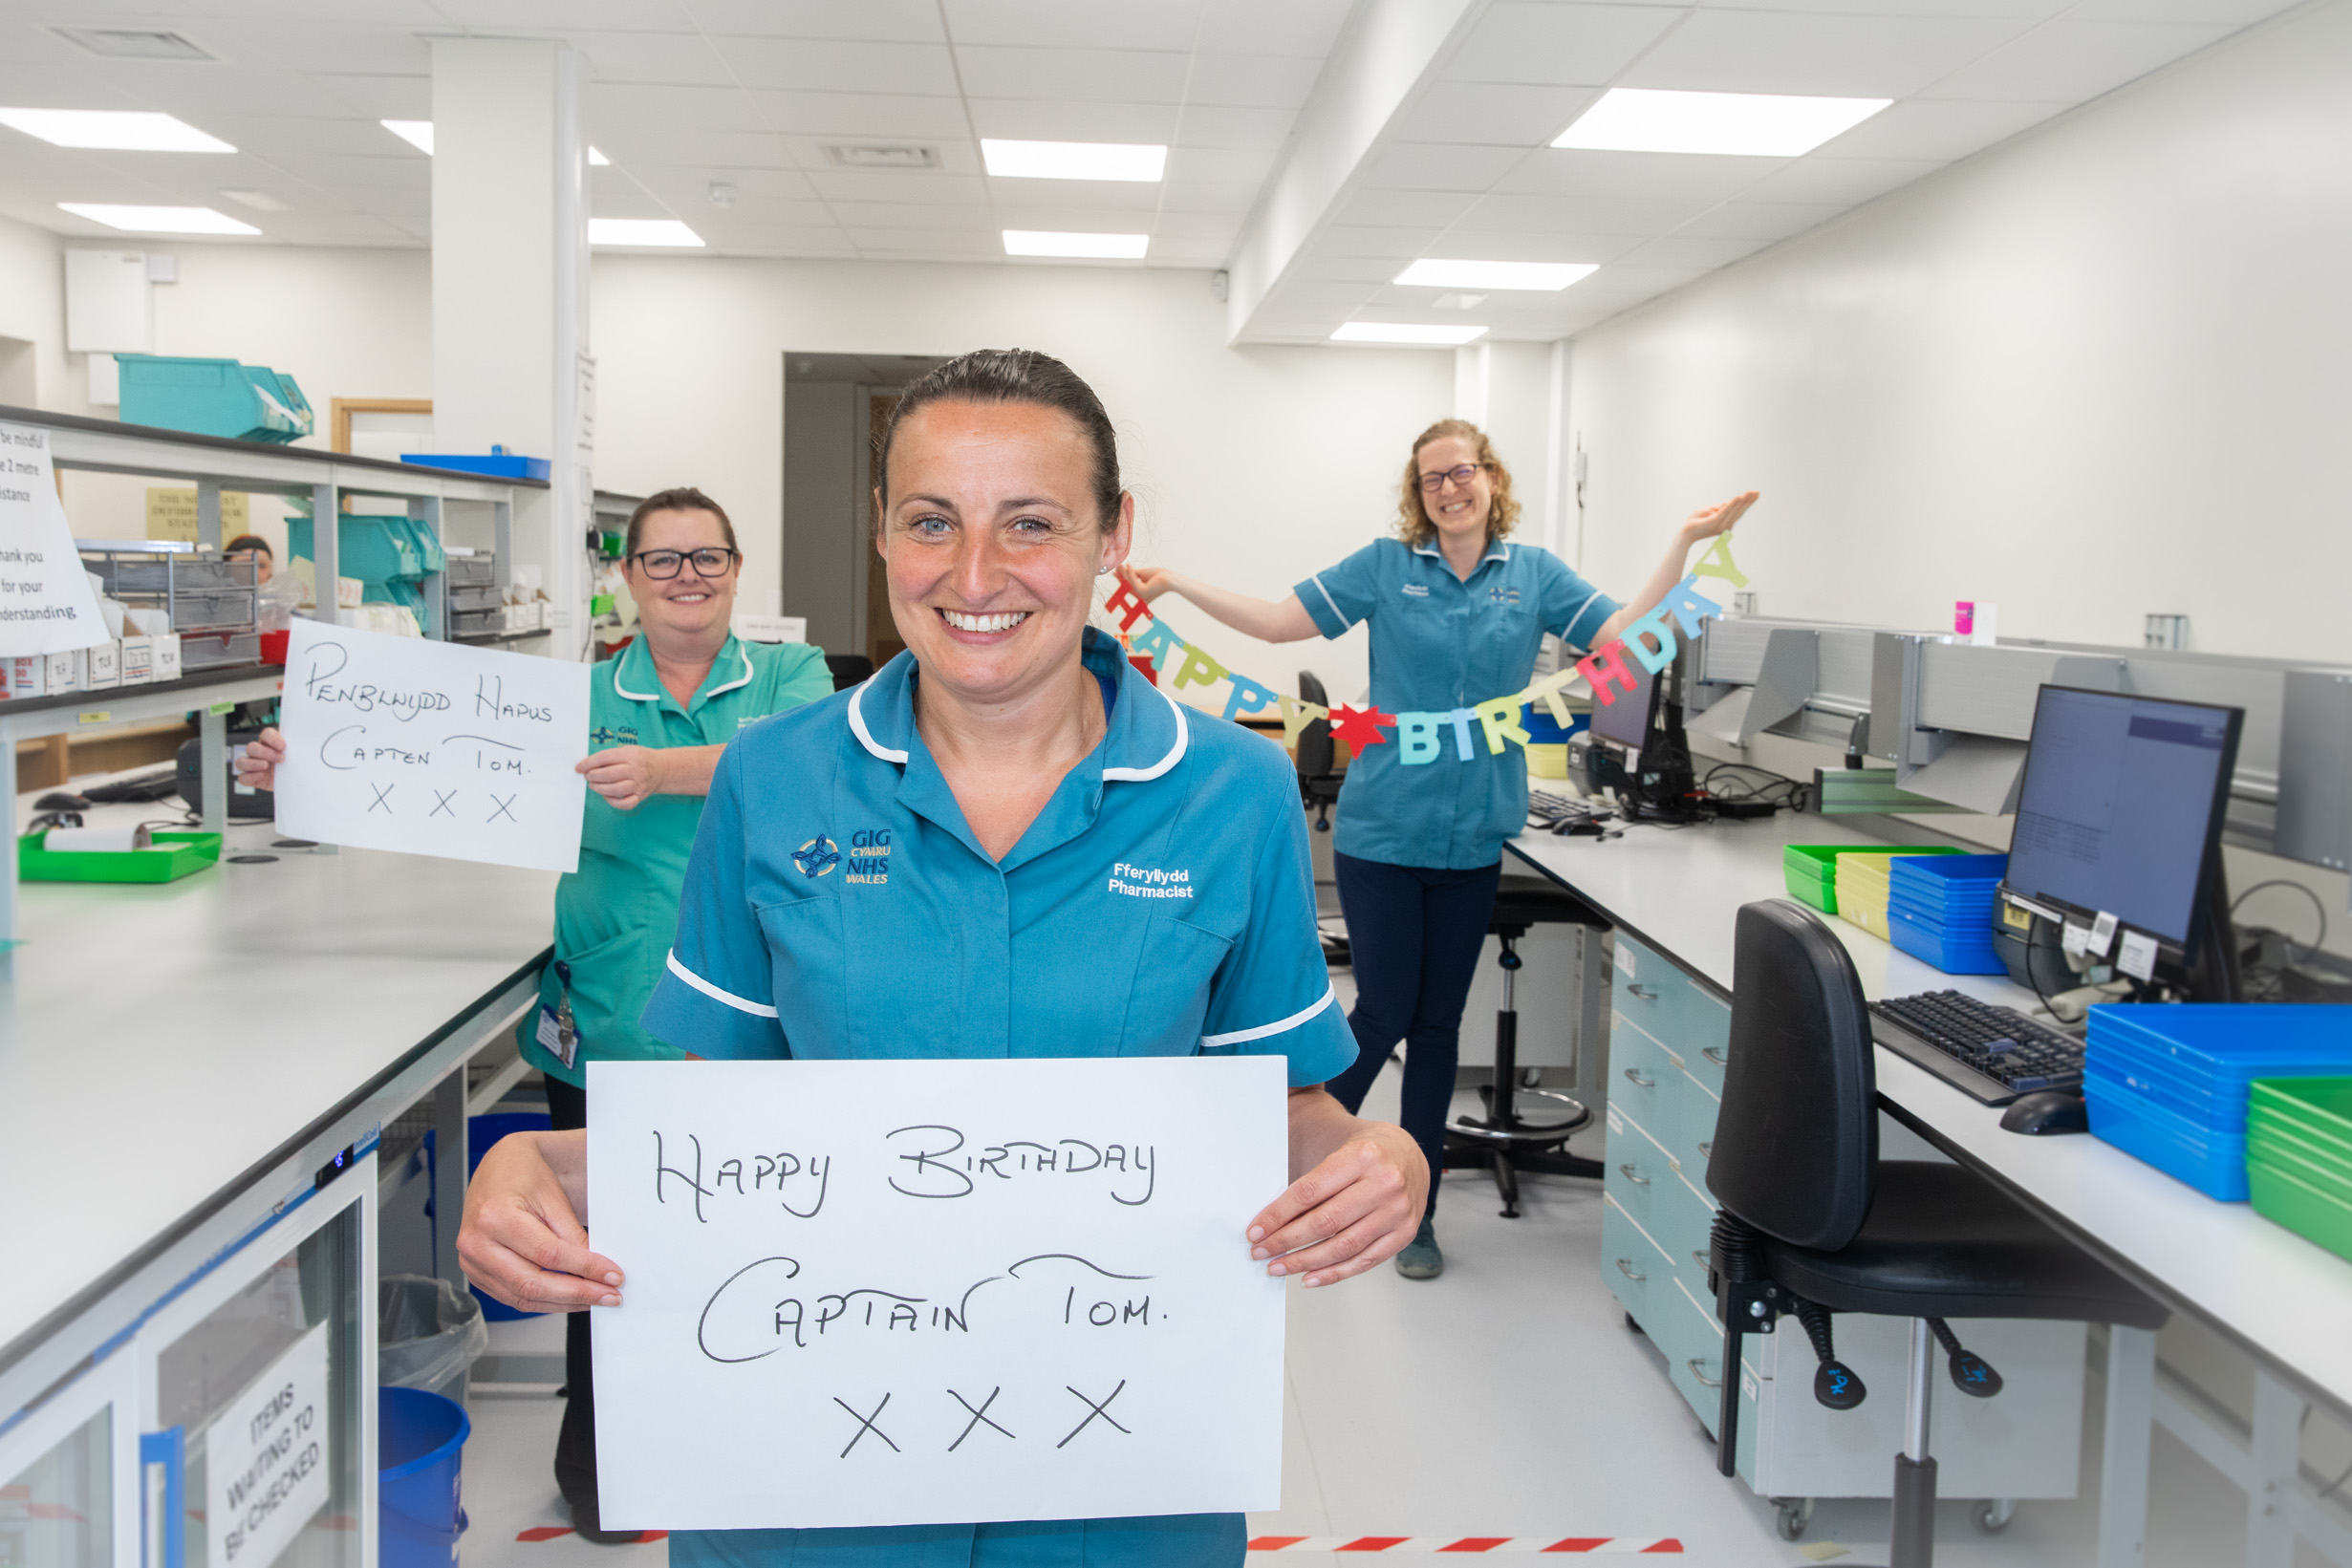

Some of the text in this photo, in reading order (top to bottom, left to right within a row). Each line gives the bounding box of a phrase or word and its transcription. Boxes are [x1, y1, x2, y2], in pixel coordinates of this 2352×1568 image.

[8, 459, 13, 473] 2
[15, 462, 39, 477] metre
[24, 551, 44, 566] you
[1, 578, 43, 595] for your
[1105, 529, 1749, 764] HAPPY BIRTHDAY
[475, 674, 552, 722] HAPUS
[617, 736, 638, 745] NHS
[618, 726, 638, 736] GIG
[320, 724, 430, 770] CAPTEN
[852, 828, 892, 848] GIG
[850, 846, 892, 857] CYMRU
[846, 857, 890, 874] NHS
[1113, 863, 1190, 886] Fferyllydd
[845, 874, 889, 885] WALES
[1109, 878, 1194, 898] Pharmacist
[653, 1124, 1155, 1223] HAPPY BIRTHDAY
[698, 1256, 1004, 1364] CAPTAIN
[249, 1382, 295, 1447] ITEMS
[227, 1405, 314, 1513] WAITING TO
[247, 1441, 320, 1533] CHECKED
